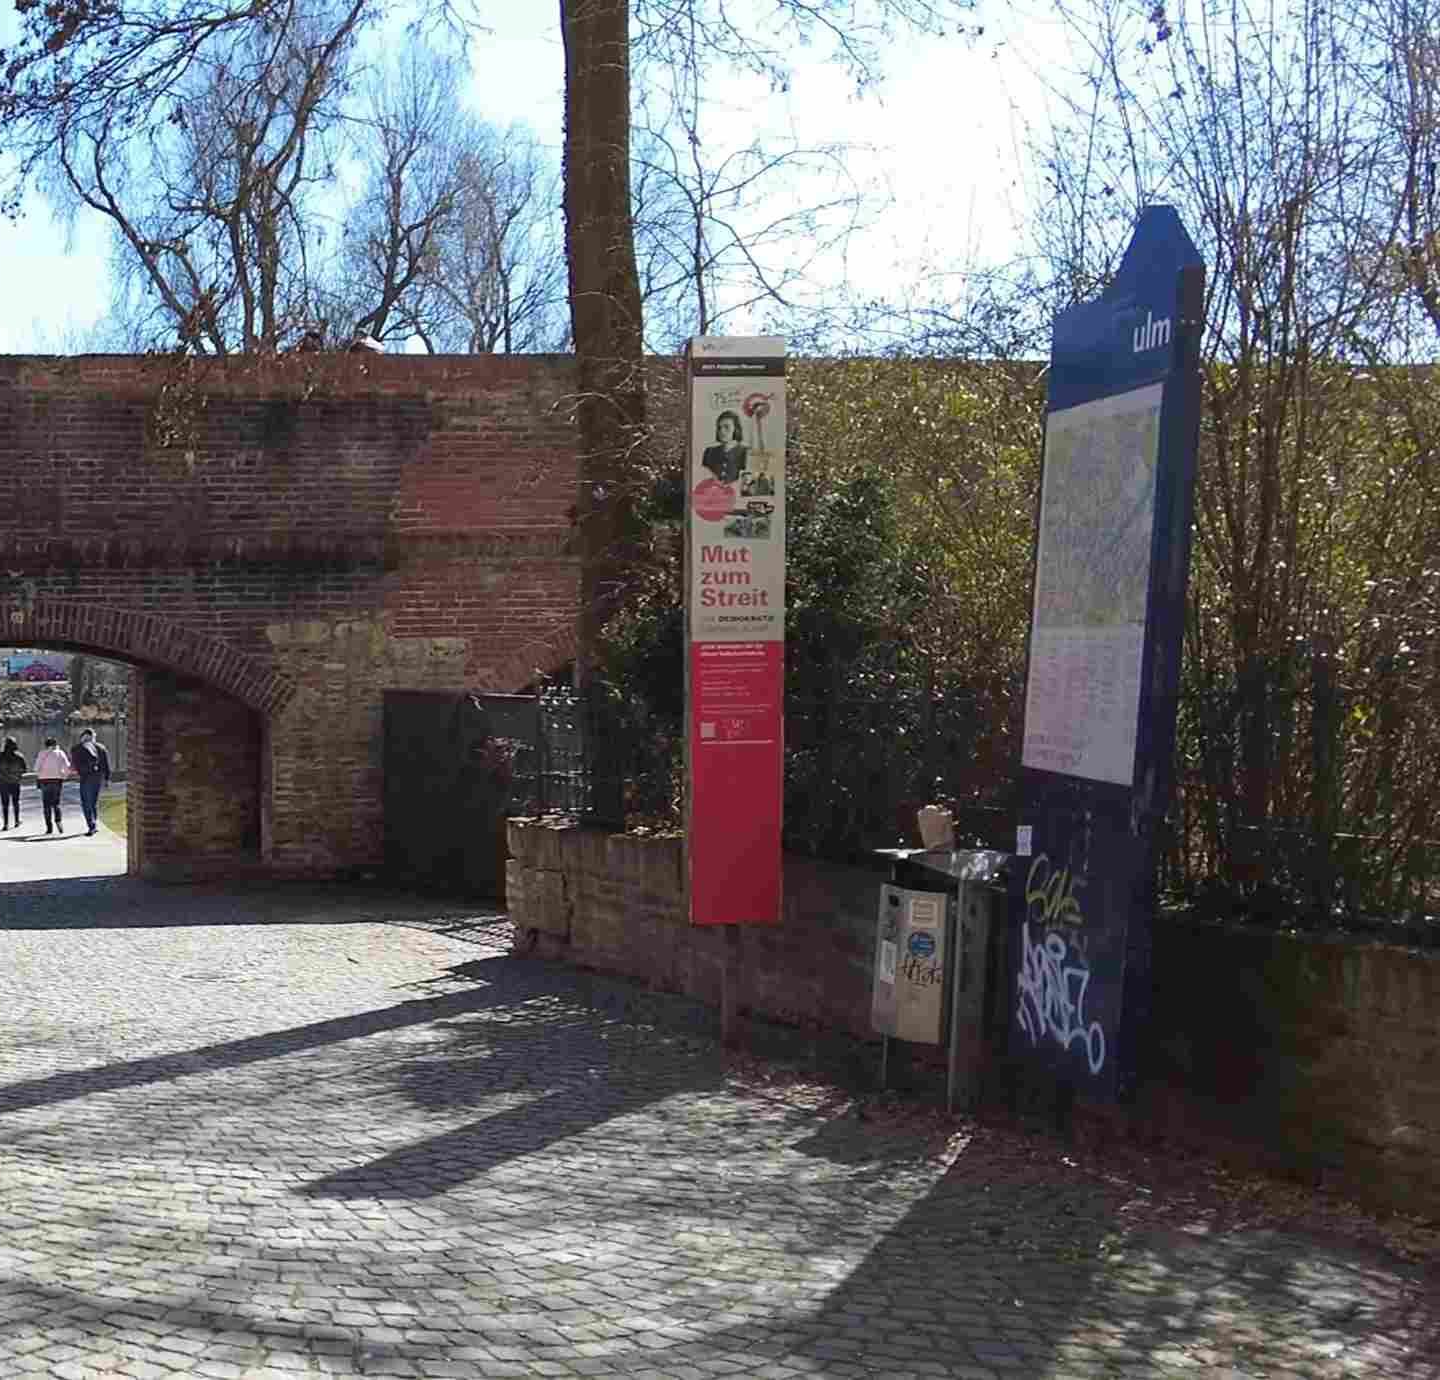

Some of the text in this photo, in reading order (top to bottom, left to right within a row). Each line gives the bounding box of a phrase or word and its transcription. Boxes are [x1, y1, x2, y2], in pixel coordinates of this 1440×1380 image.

[1133, 311, 1171, 352] ulm
[702, 545, 750, 562] Mut
[702, 571, 750, 585] zum
[702, 588, 769, 607] Streit
